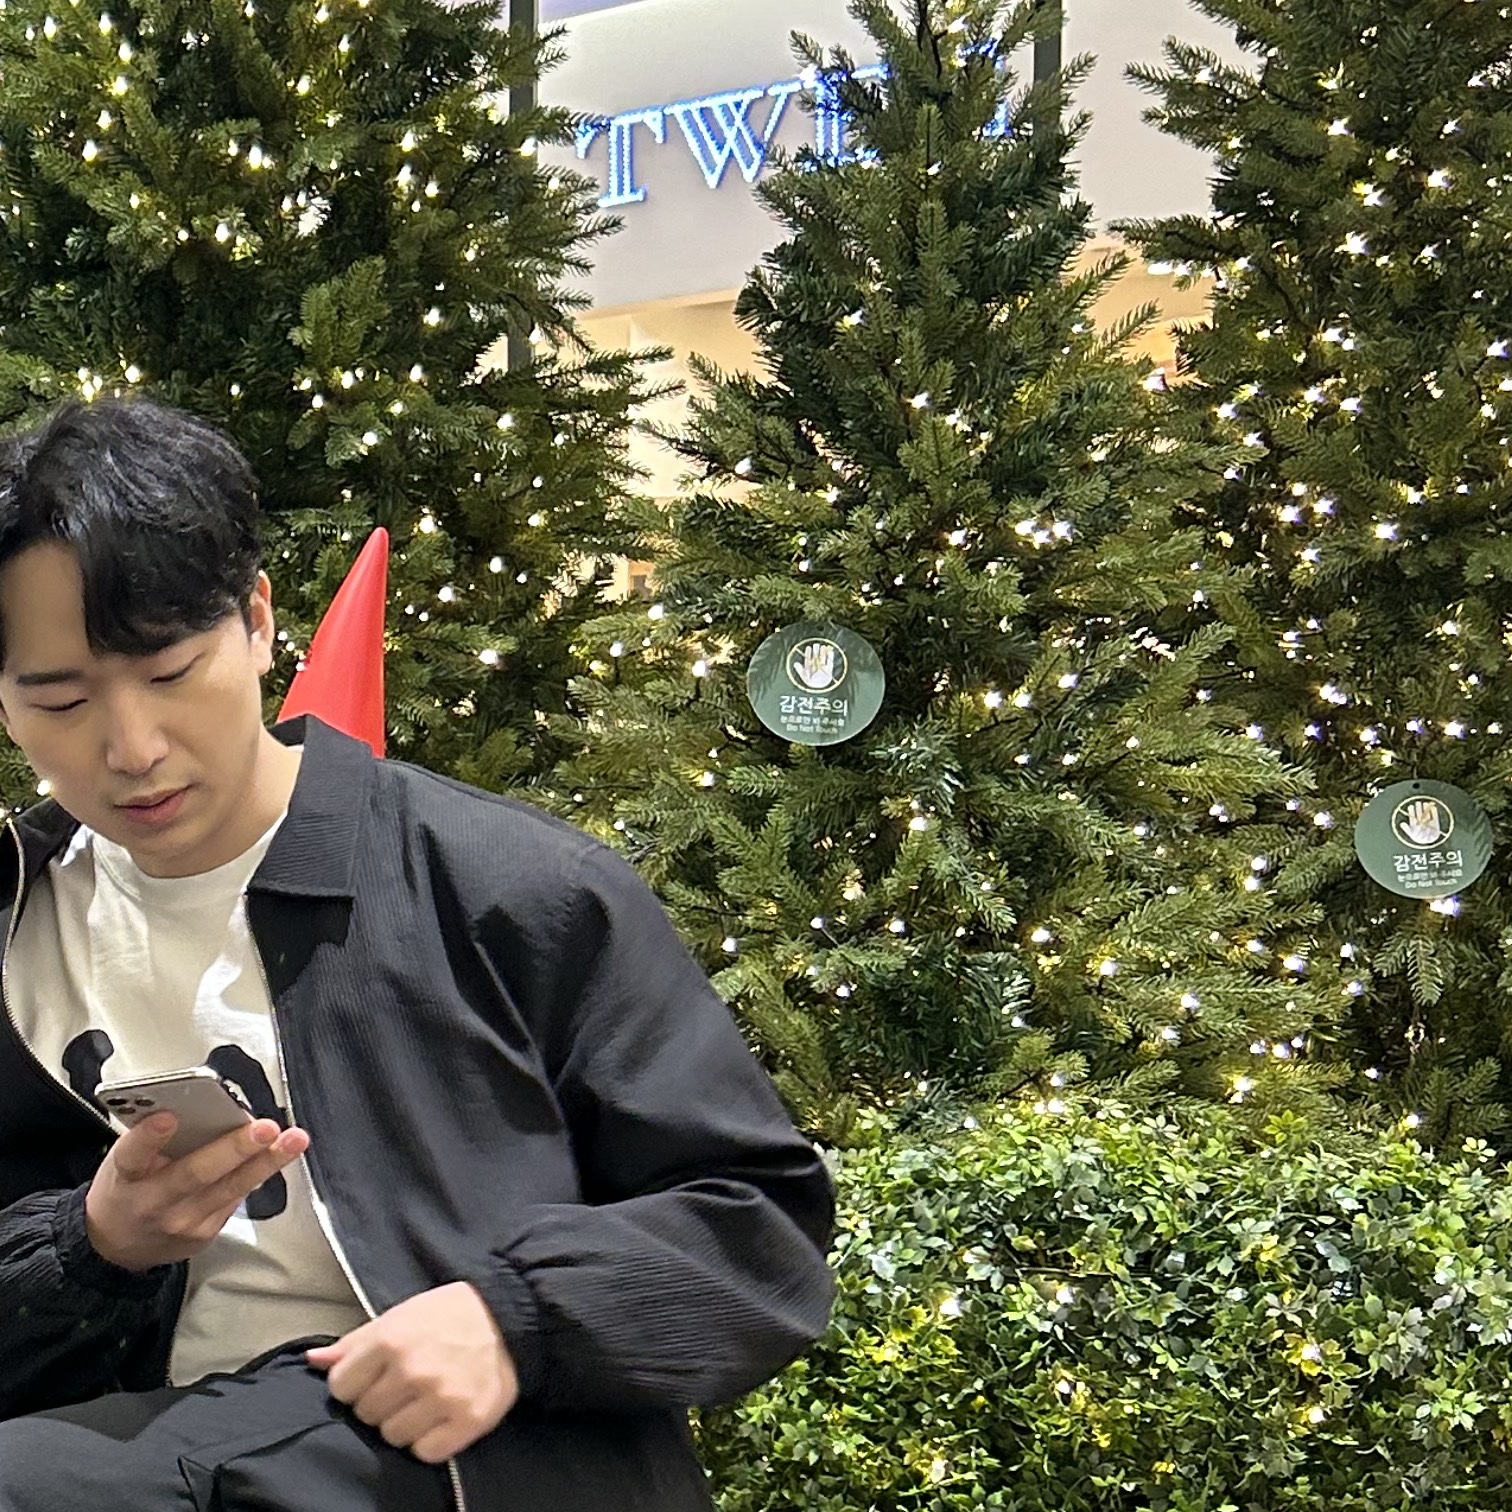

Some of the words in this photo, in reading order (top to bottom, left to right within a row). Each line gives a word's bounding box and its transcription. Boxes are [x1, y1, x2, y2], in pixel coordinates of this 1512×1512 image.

[779, 695, 848, 717] 감전주의
[786, 723, 798, 732] Do
[1392, 849, 1463, 873] 감전주의
[1404, 881, 1418, 889] Do
